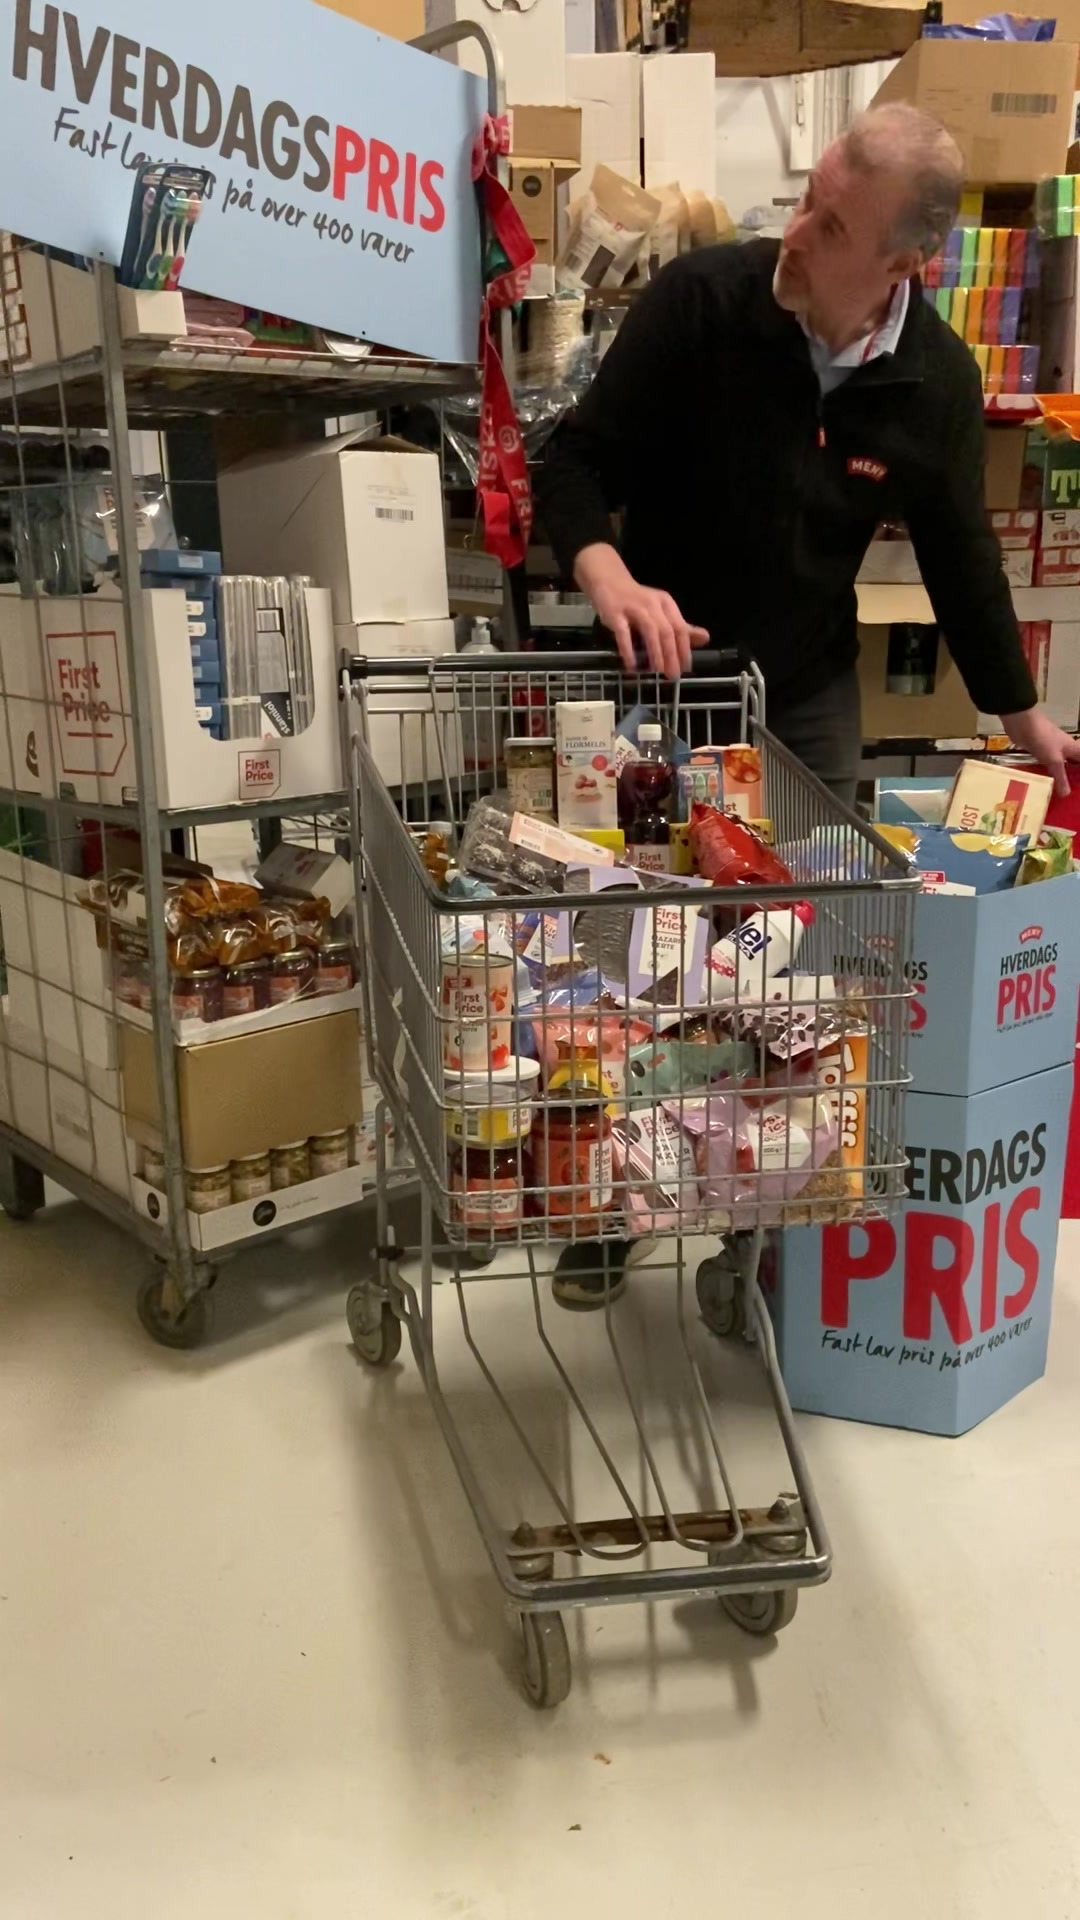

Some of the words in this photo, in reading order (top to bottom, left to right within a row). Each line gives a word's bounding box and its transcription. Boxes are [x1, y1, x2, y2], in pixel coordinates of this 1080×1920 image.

[12, 0, 446, 233] HVERDAGSPRIS
[53, 107, 118, 162] Fast
[120, 132, 179, 169] la
[222, 179, 257, 214] på
[261, 196, 307, 229] over
[312, 211, 353, 245] 400
[360, 228, 415, 264] varer
[57, 658, 101, 690] First
[61, 691, 111, 723] Price
[263, 701, 292, 735] stanniol
[245, 759, 270, 770] First
[245, 771, 274, 781] Price
[638, 852, 662, 862] First
[638, 861, 665, 871] Price
[1000, 943, 1058, 976] HVERDAGS
[997, 964, 1057, 1026] PRIS
[868, 1122, 1047, 1204] ERDAGS
[821, 1186, 1041, 1345] PRIS
[821, 1329, 862, 1352] Fast
[866, 1331, 893, 1358] lav
[899, 1349, 935, 1366] pris
[939, 1350, 962, 1371] på
[987, 1331, 1007, 1352] 400
